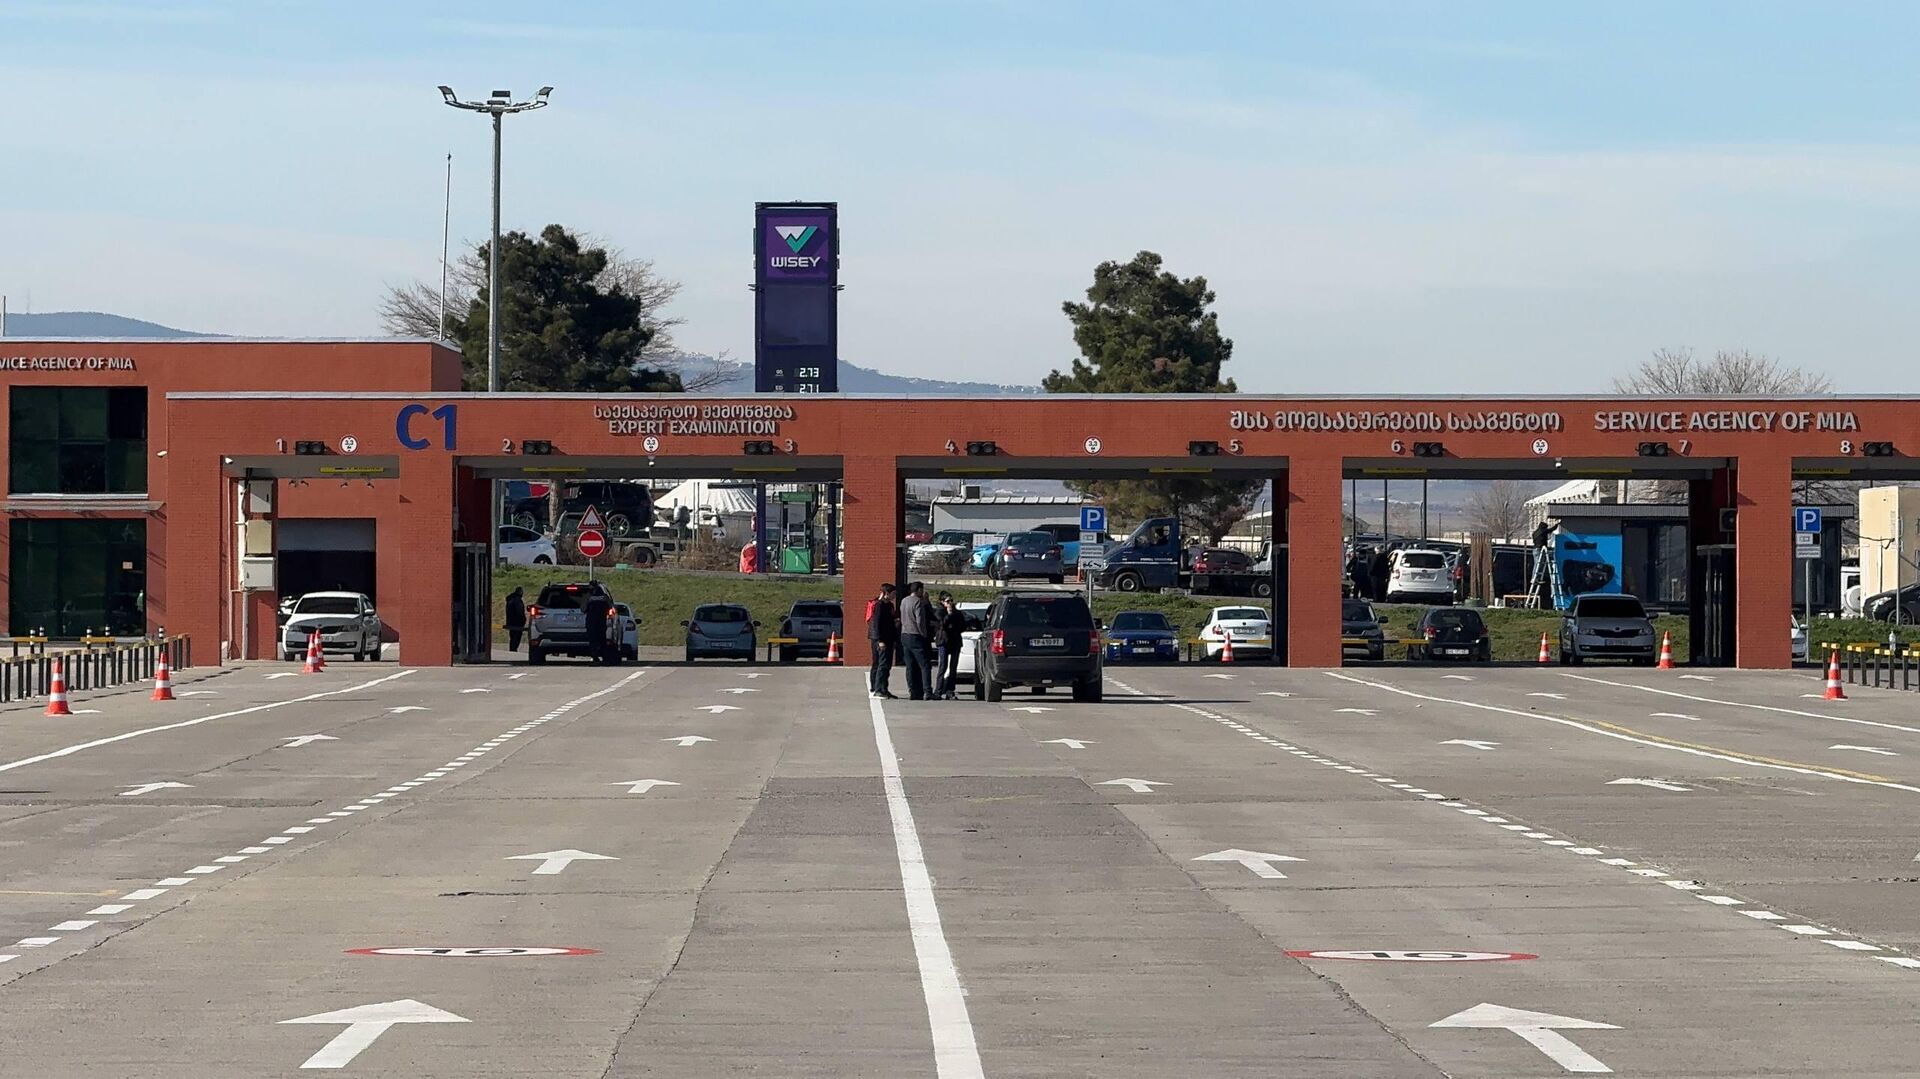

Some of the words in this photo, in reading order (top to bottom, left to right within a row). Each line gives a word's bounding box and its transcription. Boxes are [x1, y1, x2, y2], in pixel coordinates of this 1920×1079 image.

[771, 256, 820, 267] WISEY
[30, 357, 84, 369] AGENCY
[86, 357, 105, 369] OF
[107, 357, 133, 369] MIA
[799, 367, 820, 378] 2.73
[608, 420, 666, 434] EXPERT
[669, 420, 776, 434] EXAMINATION
[1230, 410, 1269, 429] შსს
[1274, 410, 1442, 430] მომსახურების
[1447, 411, 1560, 430] სააგენტო
[1593, 411, 1682, 430] SERVICE
[1688, 411, 1776, 430] AGENCY
[1780, 411, 1810, 430] OF
[1815, 411, 1858, 430] MIA
[395, 404, 458, 451] C1
[275, 438, 283, 452] 1
[502, 438, 512, 452] 2
[784, 438, 794, 452] 3
[944, 439, 955, 452] 4
[1229, 439, 1239, 452] 5
[1391, 439, 1401, 453] 6
[1678, 439, 1688, 453] 7
[1839, 440, 1851, 454] 8
[1086, 509, 1101, 529] P
[1802, 510, 1817, 530] P
